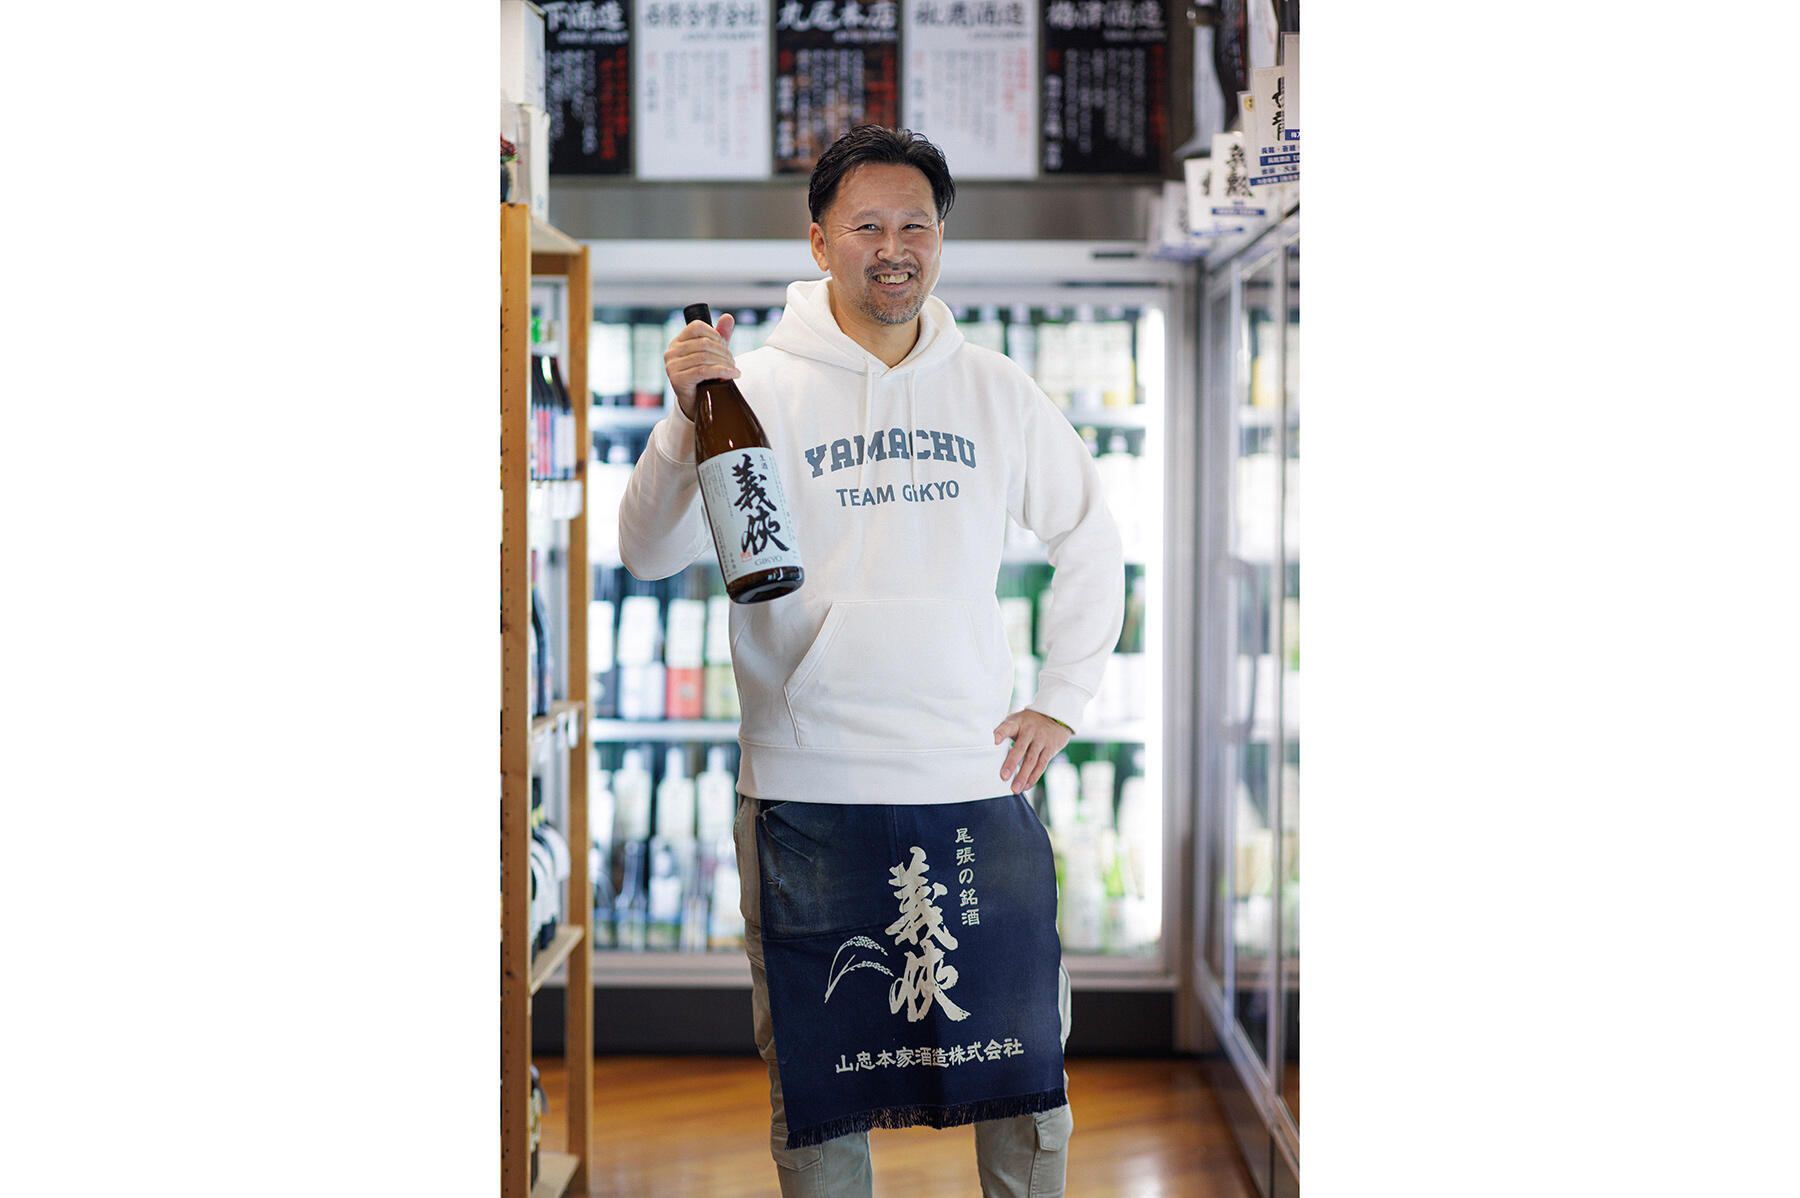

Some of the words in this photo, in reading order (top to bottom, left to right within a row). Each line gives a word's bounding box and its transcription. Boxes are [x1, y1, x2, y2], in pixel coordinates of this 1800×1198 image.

[804, 427, 977, 479] YAMACHU
[836, 484, 896, 507] TEAM
[902, 480, 960, 503] GIKYO
[955, 827, 980, 927] 尾張の銘酒
[835, 1037, 1025, 1075] 山忠本家酒造株式会社
